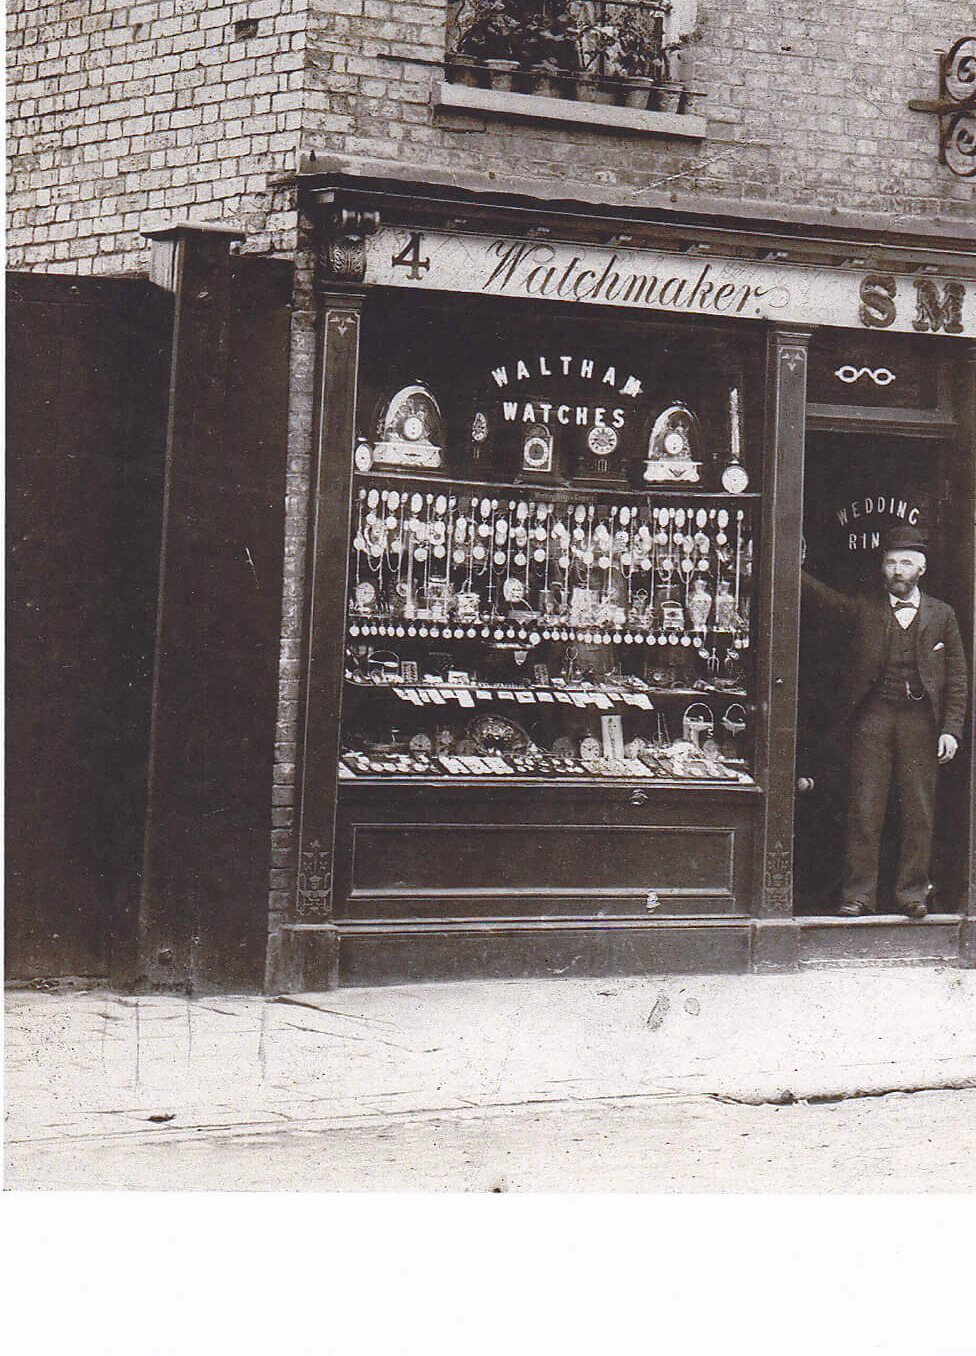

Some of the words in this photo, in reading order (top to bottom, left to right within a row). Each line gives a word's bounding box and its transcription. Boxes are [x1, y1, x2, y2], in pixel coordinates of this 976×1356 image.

[390, 231, 431, 281] 4
[491, 355, 644, 398] WALTHAM
[503, 401, 626, 429] WATCHES
[836, 496, 921, 527] WEDDING
